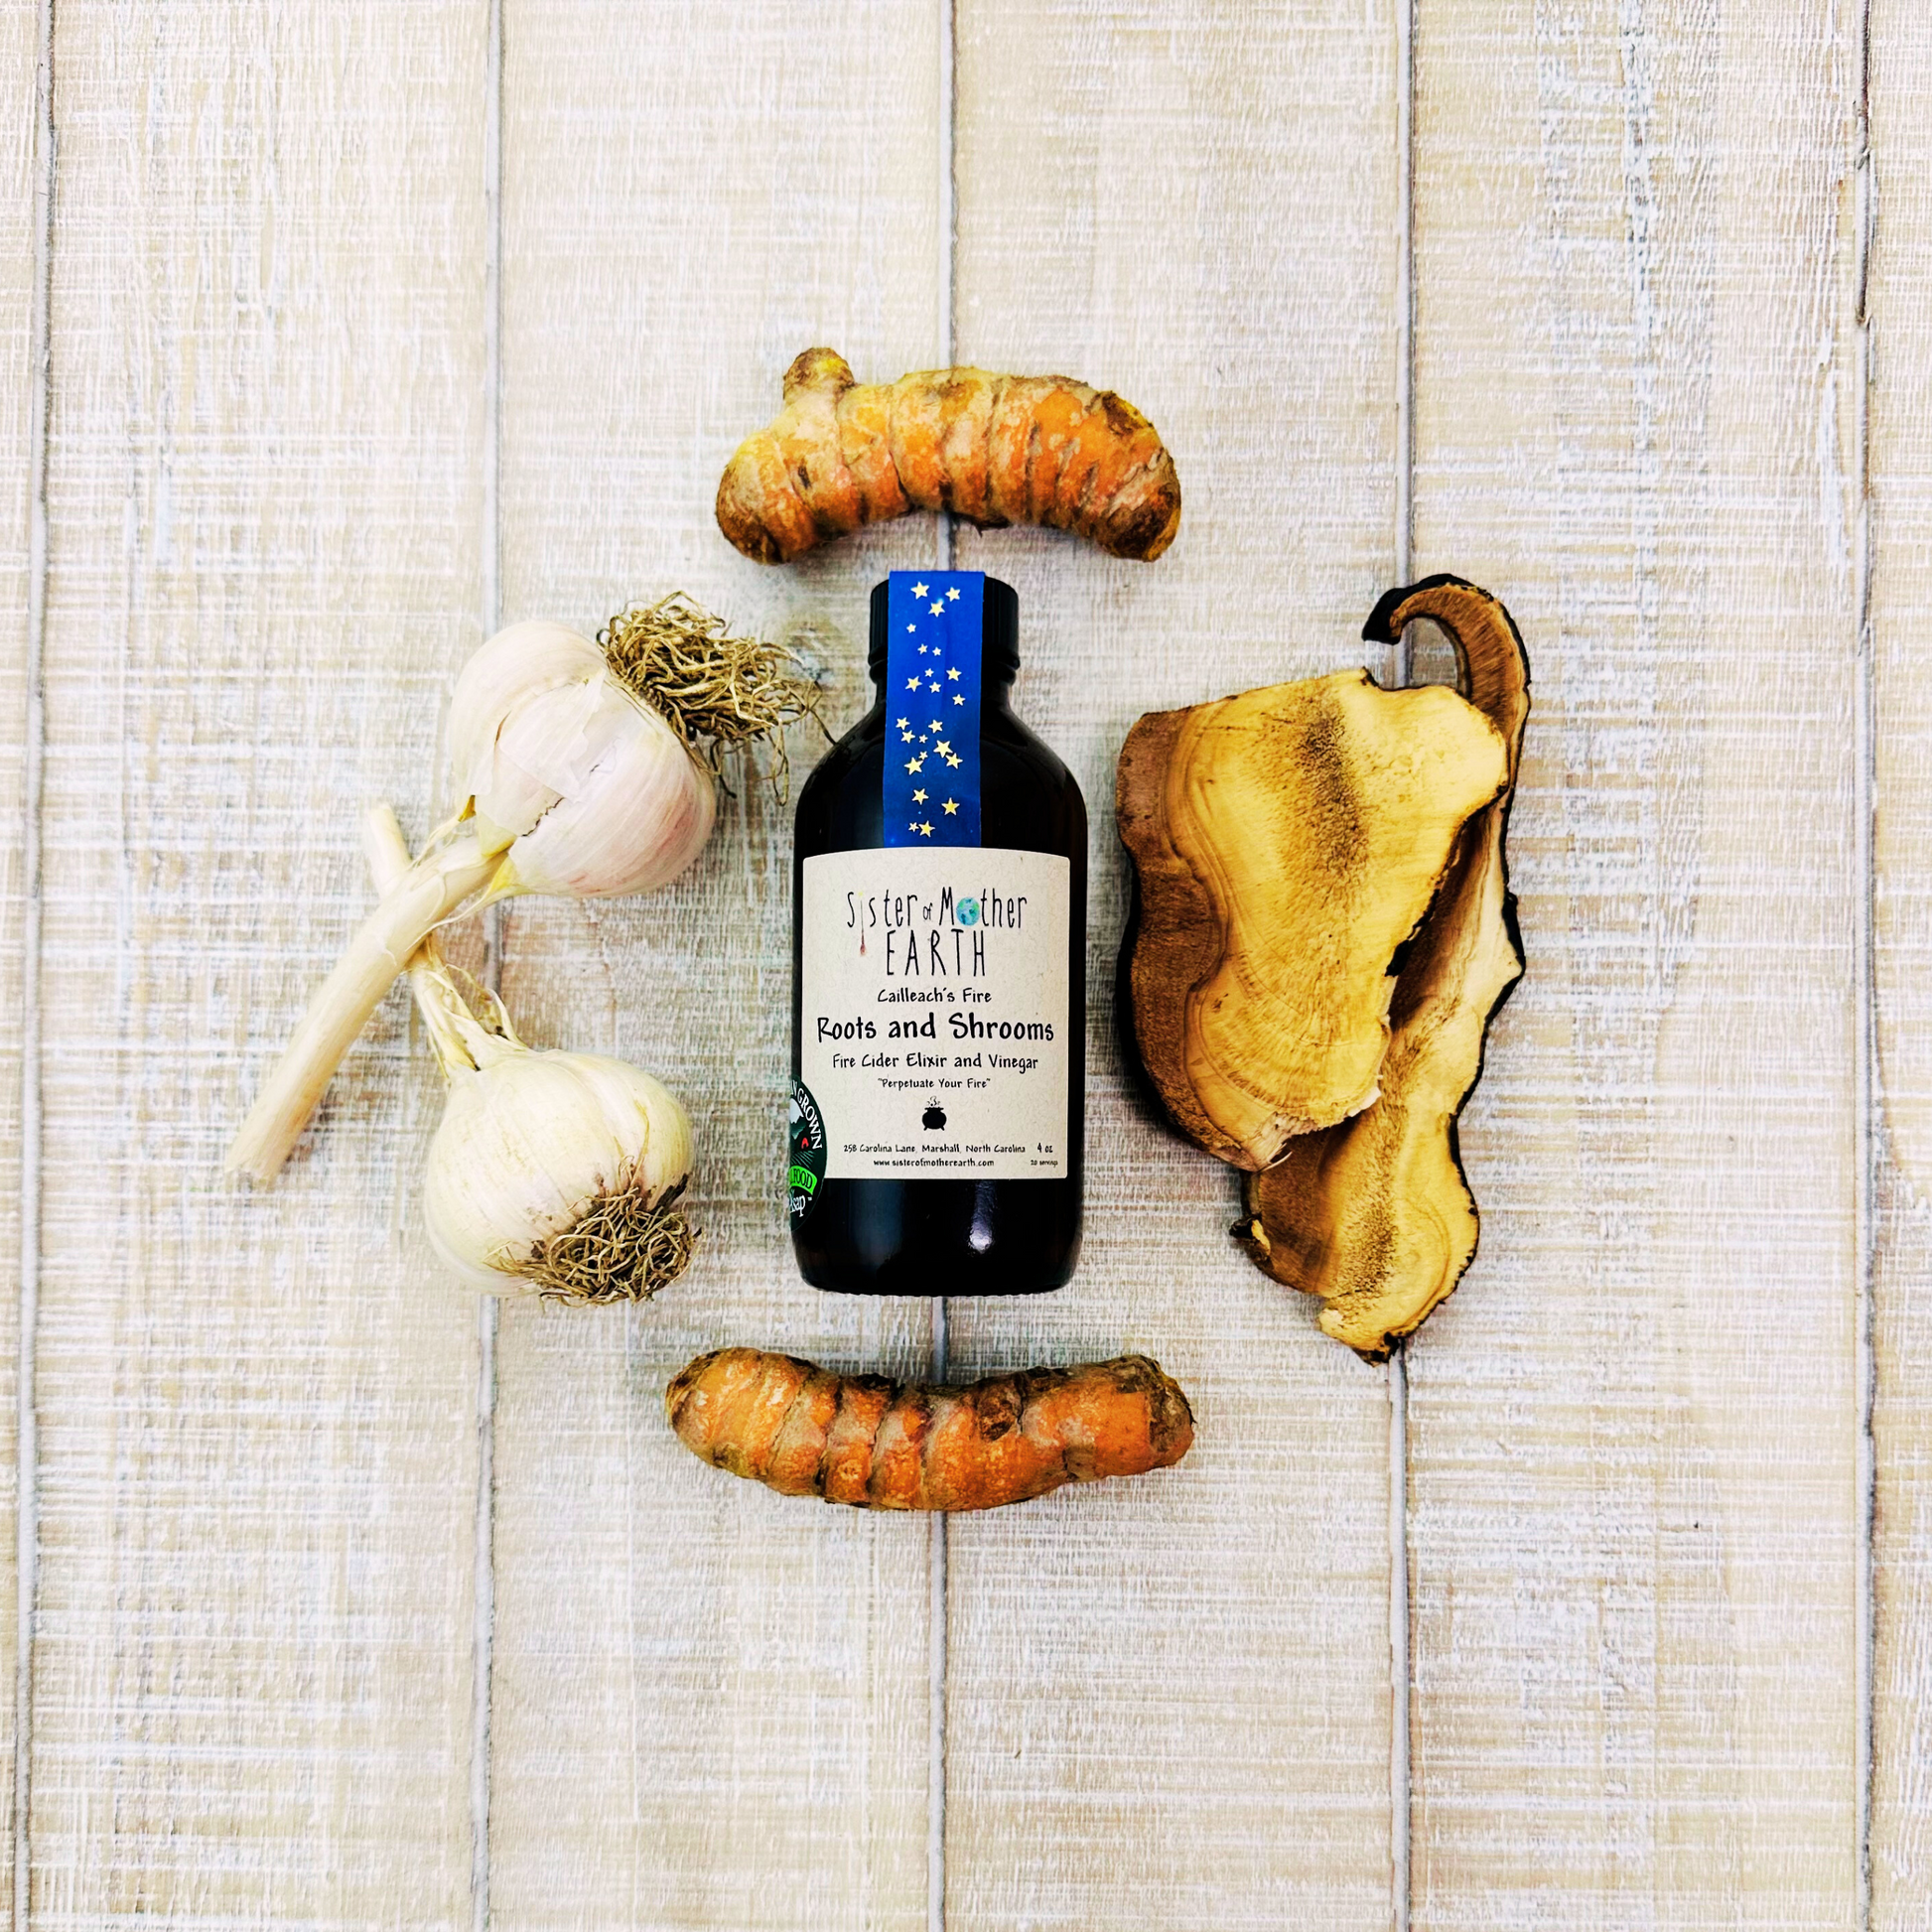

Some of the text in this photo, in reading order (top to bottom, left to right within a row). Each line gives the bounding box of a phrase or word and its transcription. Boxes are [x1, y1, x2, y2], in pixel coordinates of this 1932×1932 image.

[846, 887, 1028, 933] Sister of Mother
[886, 929, 986, 977] EARTH
[877, 987, 993, 1004] Cailleach's Fire
[817, 1011, 1054, 1043] Roots and Shrooms
[832, 1051, 1038, 1074] Fire Cider Elixir and Vinegar
[938, 1077, 963, 1088] Your
[796, 1087, 823, 1150] GROWN
[859, 1143, 893, 1153] Carolina
[965, 1144, 991, 1153] North
[993, 1144, 1026, 1154] Carolina
[1036, 1142, 1053, 1154] 4 oz
